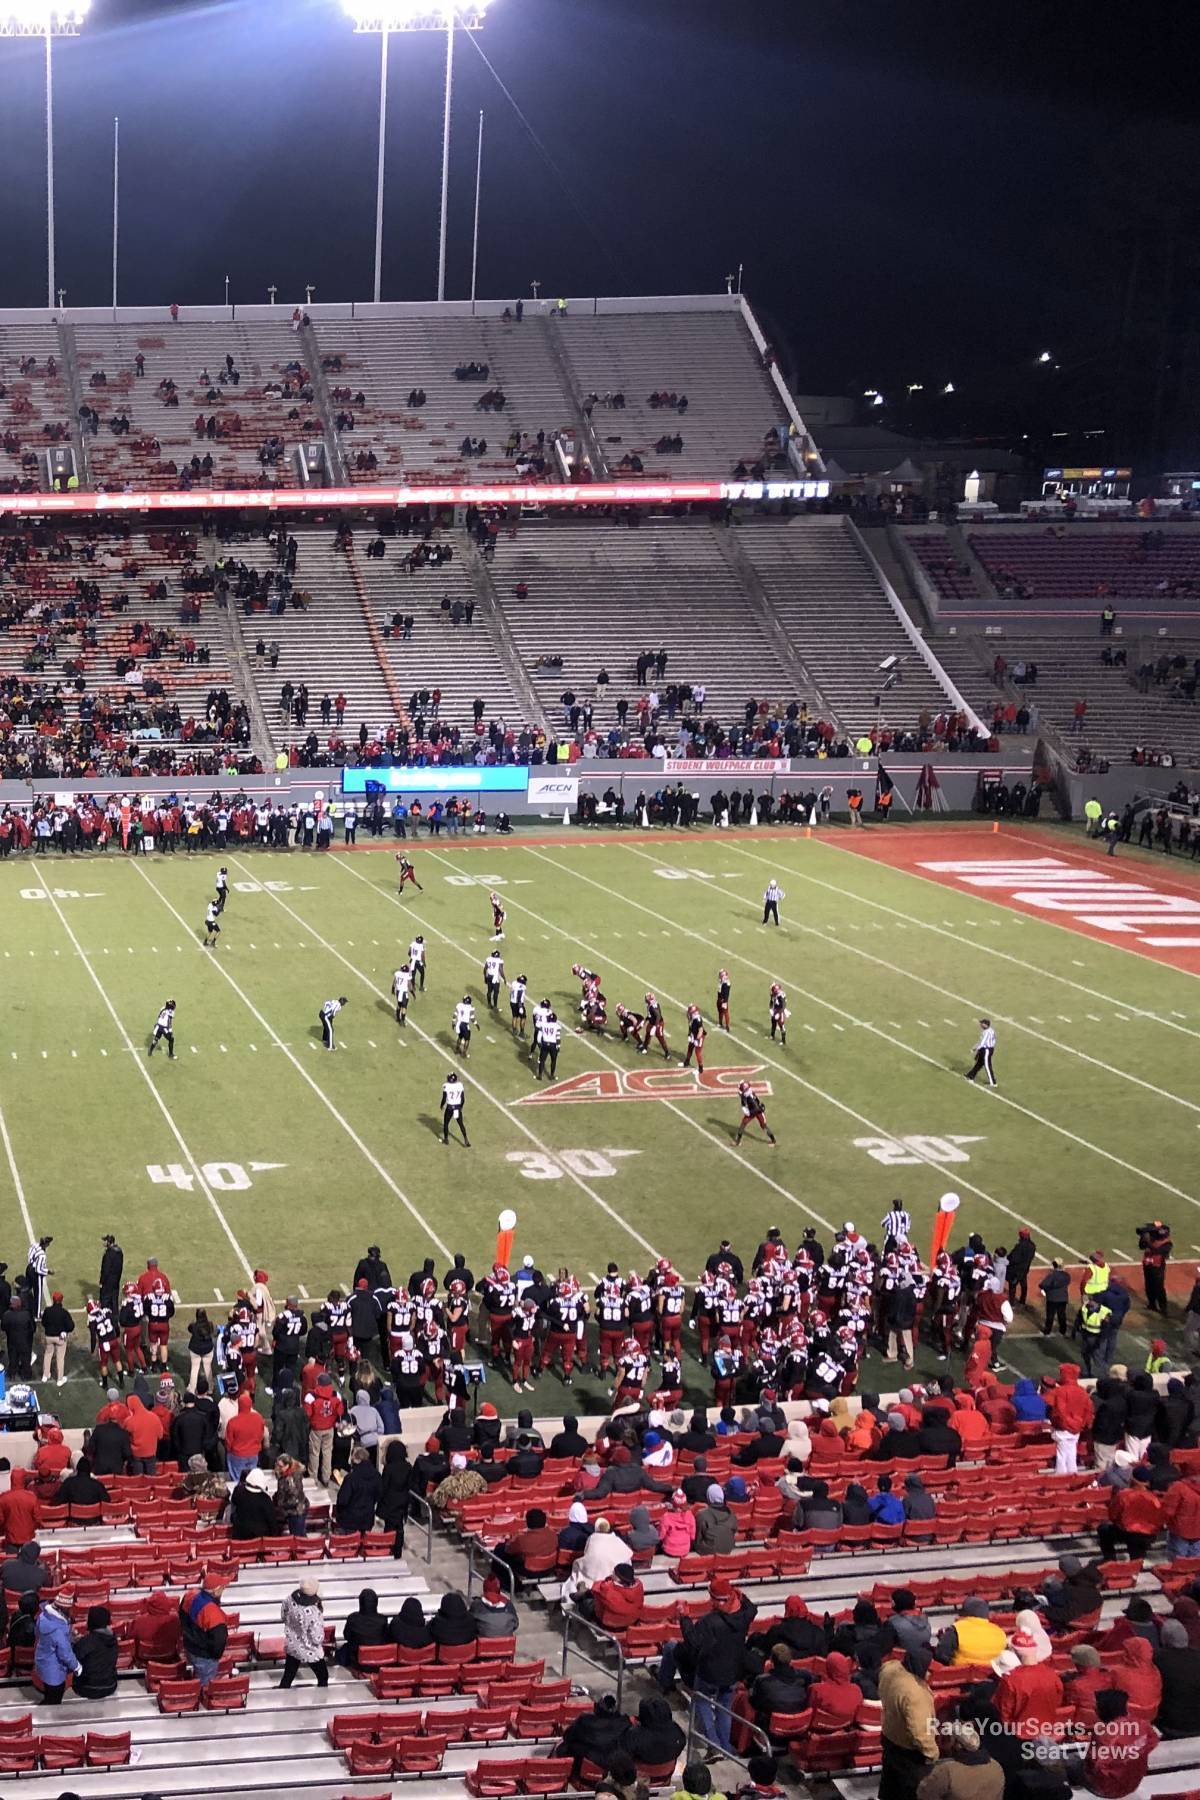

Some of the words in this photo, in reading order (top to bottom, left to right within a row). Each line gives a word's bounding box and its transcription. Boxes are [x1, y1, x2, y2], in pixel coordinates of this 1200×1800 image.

[667, 760, 705, 770] STUDENT
[706, 760, 753, 770] WOLFPACK
[753, 760, 776, 770] CLUB
[538, 784, 572, 793] ACCN
[506, 1064, 773, 1106] ACC
[852, 1135, 970, 1165] 20
[146, 1160, 253, 1191] 40
[504, 1148, 617, 1180] 30
[828, 1277, 845, 1289] 54
[97, 1319, 113, 1336] 33
